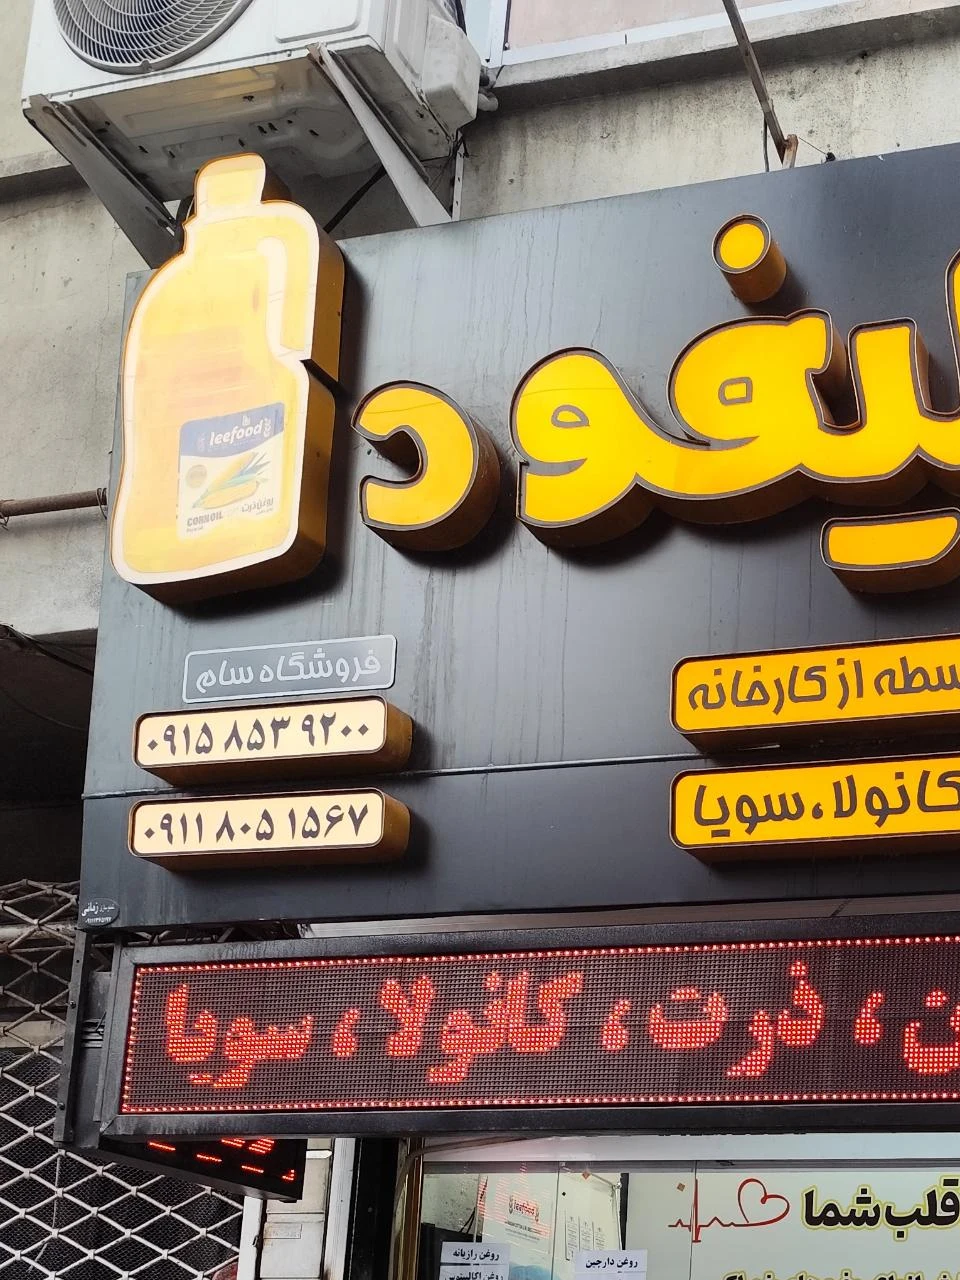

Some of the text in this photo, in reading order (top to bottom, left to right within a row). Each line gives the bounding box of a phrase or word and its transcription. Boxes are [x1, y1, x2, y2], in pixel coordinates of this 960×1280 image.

[209, 419, 264, 448] leefood
[195, 647, 382, 694] فروشگاه سام
[687, 664, 828, 716] کارخانه
[837, 658, 865, 711] از
[146, 711, 369, 758] ۰۹۱۵ ۸۵۳ ۹۲۰۰
[144, 802, 369, 846] ۰۹۱۱ ۸۰۵ ۱۵۶۷
[693, 784, 806, 839] سویا
[804, 1187, 881, 1227] شما
[884, 1178, 960, 1239] قلب
[452, 1249, 500, 1261] روغن رازیانه
[616, 1257, 638, 1269] روغن
